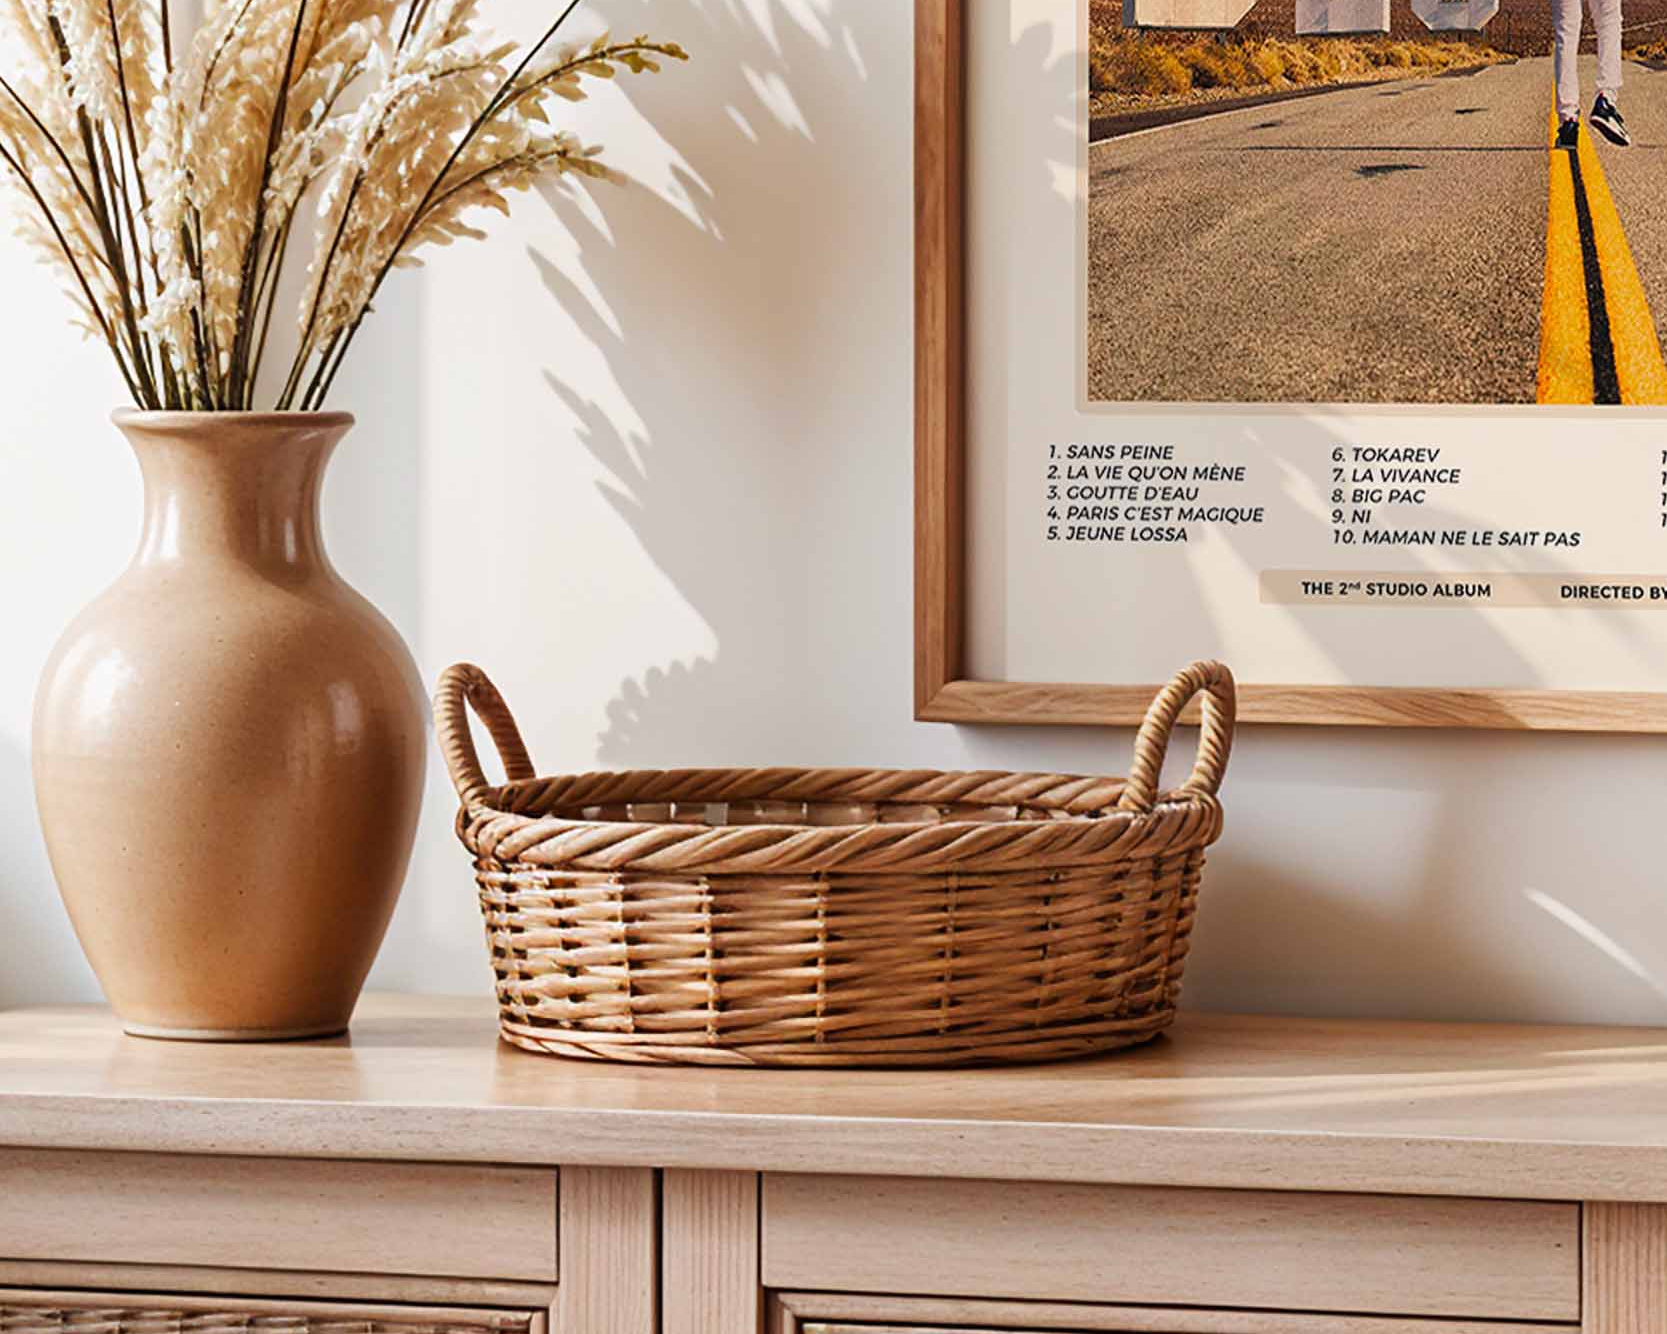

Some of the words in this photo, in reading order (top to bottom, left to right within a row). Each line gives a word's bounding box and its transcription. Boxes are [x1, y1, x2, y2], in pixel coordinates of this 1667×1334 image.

[1049, 445, 1062, 460] 1.
[1066, 445, 1116, 460] SANS
[1119, 445, 1174, 460] PEINE
[1332, 447, 1346, 463] 6.
[1351, 447, 1441, 463] TOKAREV
[1046, 464, 1062, 480] 2.
[1066, 465, 1090, 480] LA
[1094, 465, 1124, 480] VIE
[1192, 464, 1246, 482] MÈNE
[1332, 467, 1346, 482] 7.
[1351, 467, 1377, 483] LA
[1379, 468, 1461, 484] VIVANCE
[1047, 484, 1062, 501] 3.
[1066, 485, 1140, 501] GOUTTE
[1331, 488, 1346, 504] 8.
[1351, 488, 1383, 504] BIG
[1387, 488, 1426, 504] PAC
[1047, 506, 1061, 521] 4.
[1066, 505, 1120, 521] PARIS
[1177, 506, 1265, 525] MAGIQUE
[1331, 508, 1346, 524] 9.
[1351, 508, 1372, 524] NI
[1046, 526, 1061, 541] 5.
[1065, 526, 1126, 541] JEUNE
[1130, 526, 1188, 542] LOSSA
[1334, 529, 1357, 545] 10.
[1361, 529, 1436, 545] MAMAN
[1440, 530, 1468, 546] NE
[1471, 530, 1494, 546] LE
[1497, 531, 1541, 546] SAIT
[1543, 531, 1581, 547] PAS
[1301, 581, 1334, 596] THE
[1365, 582, 1428, 597] STUDIO
[1432, 583, 1492, 598] ALBUM
[1561, 582, 1644, 600] DIRECTED
